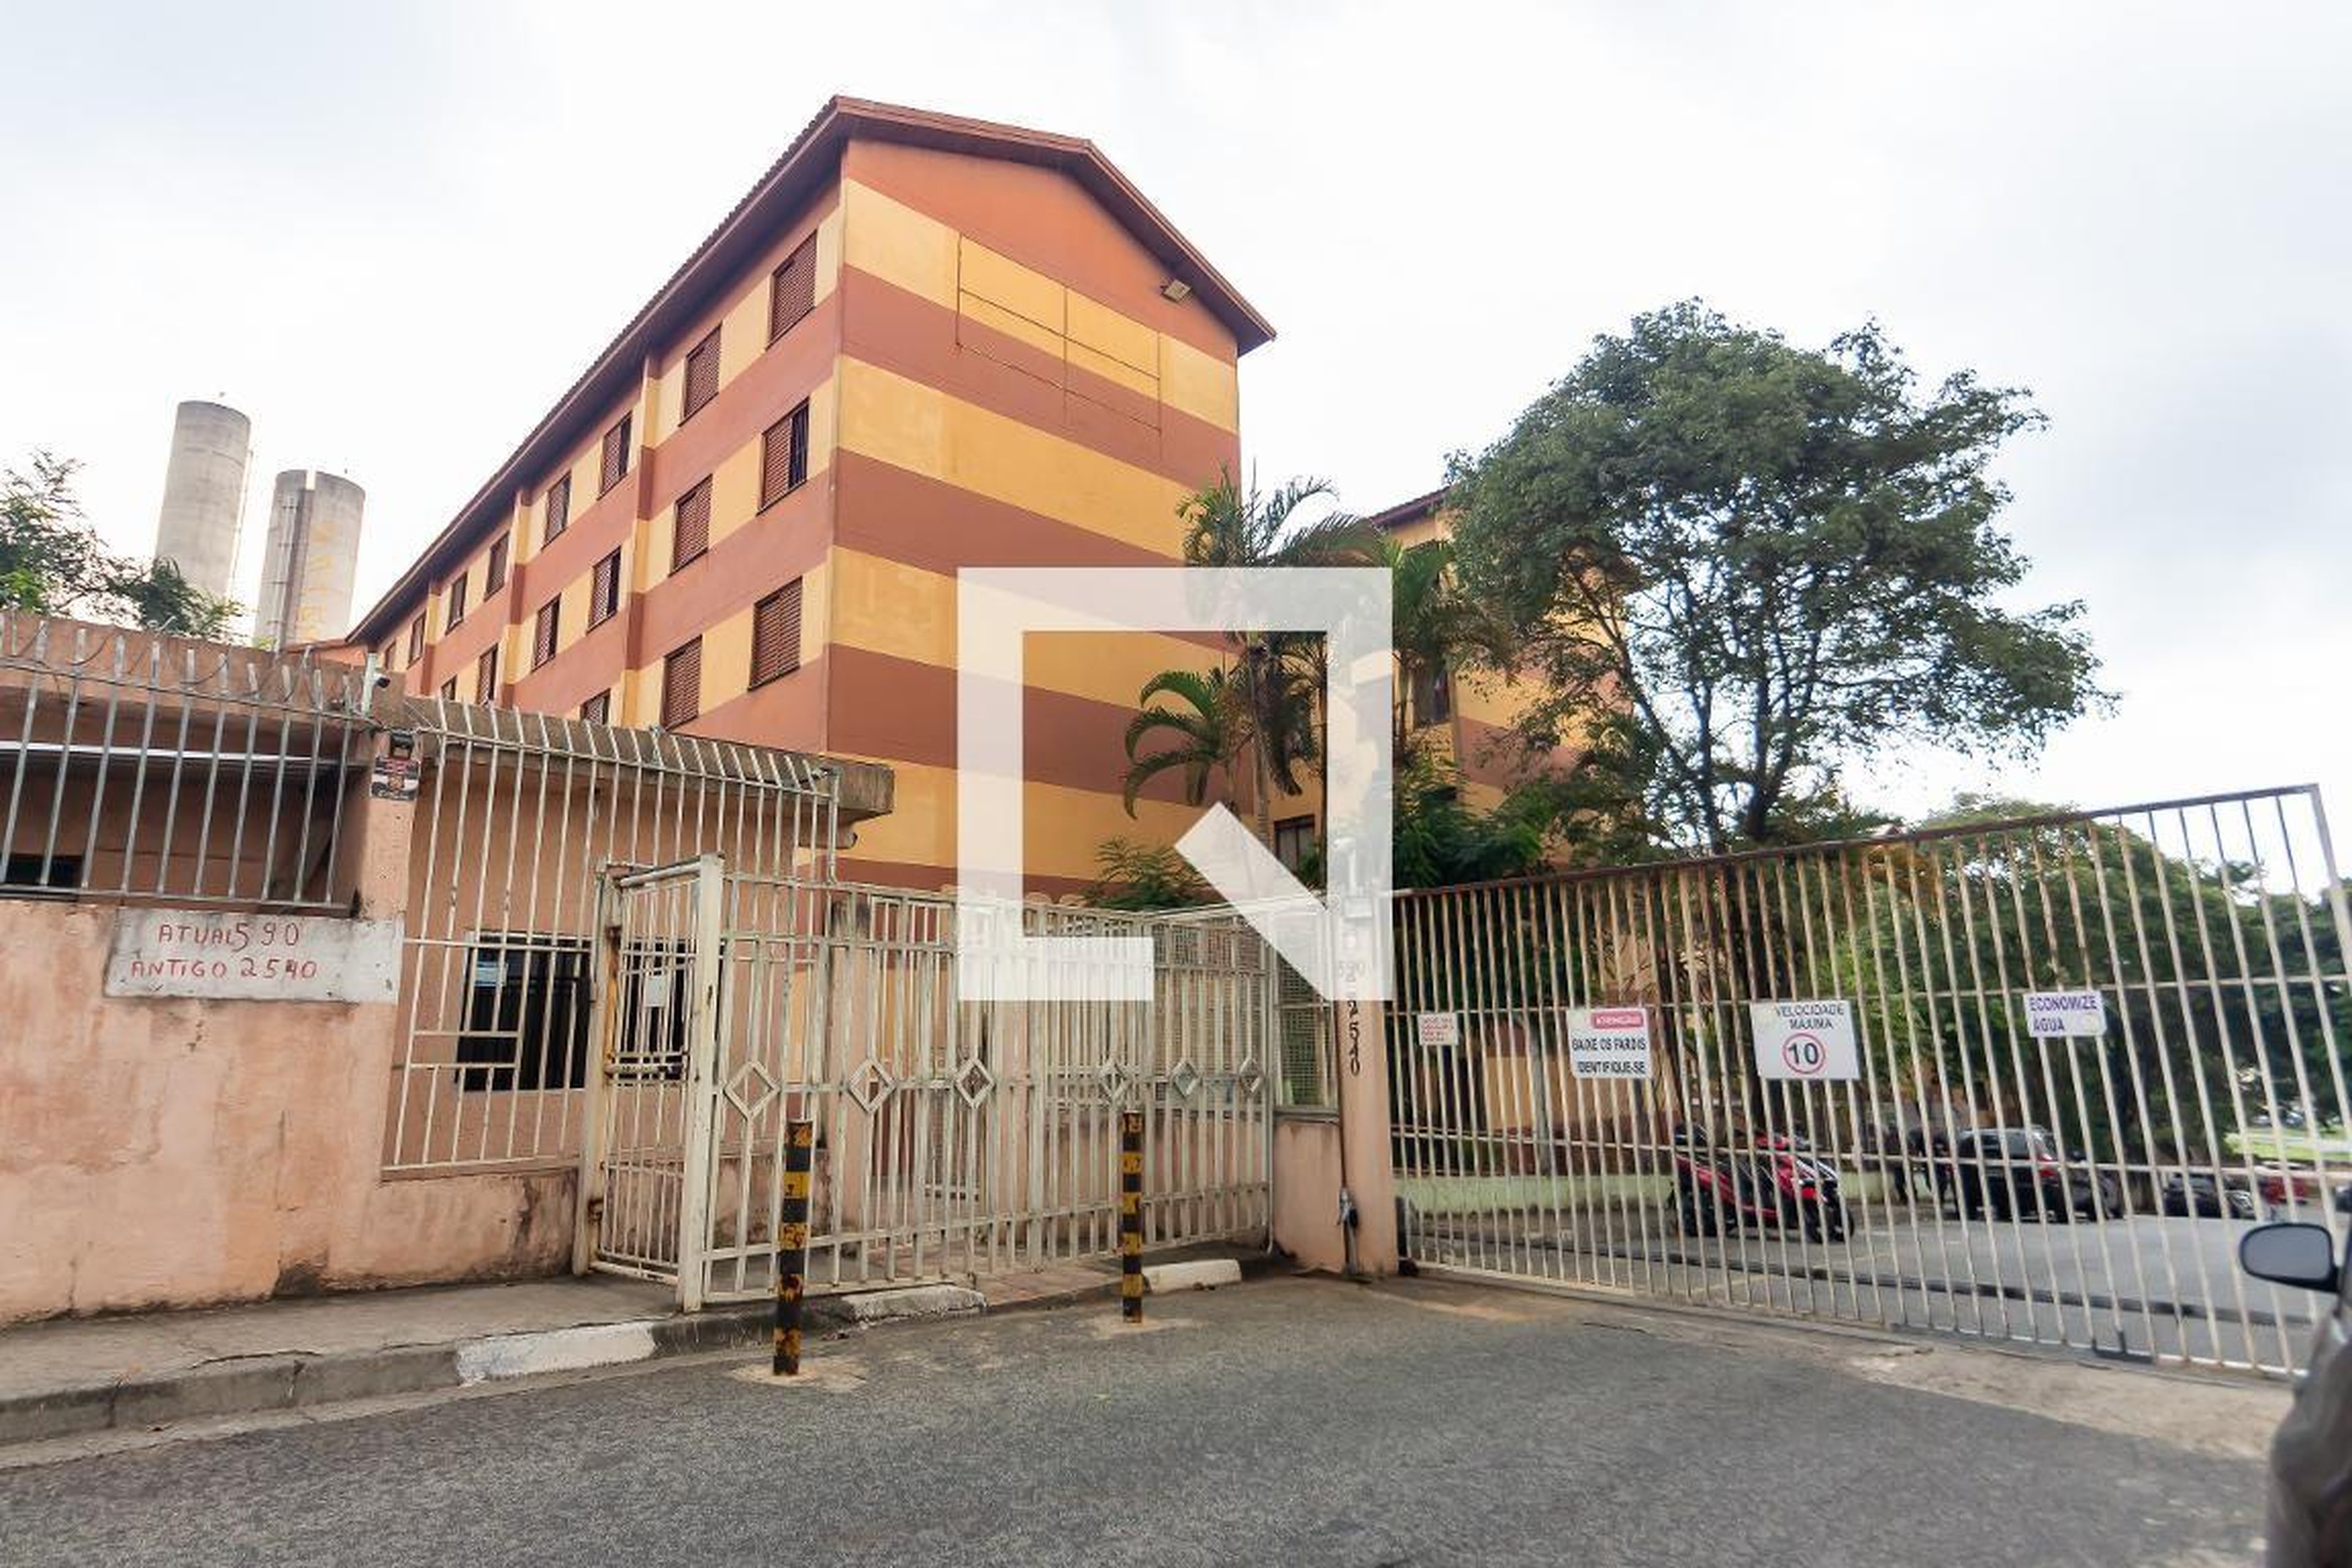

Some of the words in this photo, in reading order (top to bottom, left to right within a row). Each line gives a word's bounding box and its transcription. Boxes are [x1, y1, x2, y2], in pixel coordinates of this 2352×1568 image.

[159, 924, 230, 944] ATUAL
[231, 922, 299, 952] 590
[130, 959, 227, 978] ANTIGO
[241, 957, 317, 979] 2540
[1776, 1003, 1844, 1017] VELOCIDADE
[2029, 995, 2097, 1011] ECONOMIZE
[1600, 1038, 1611, 1050] OS
[1788, 1042, 1819, 1065] 10
[1577, 1061, 1646, 1074] IDENTIFIQUE-SE
